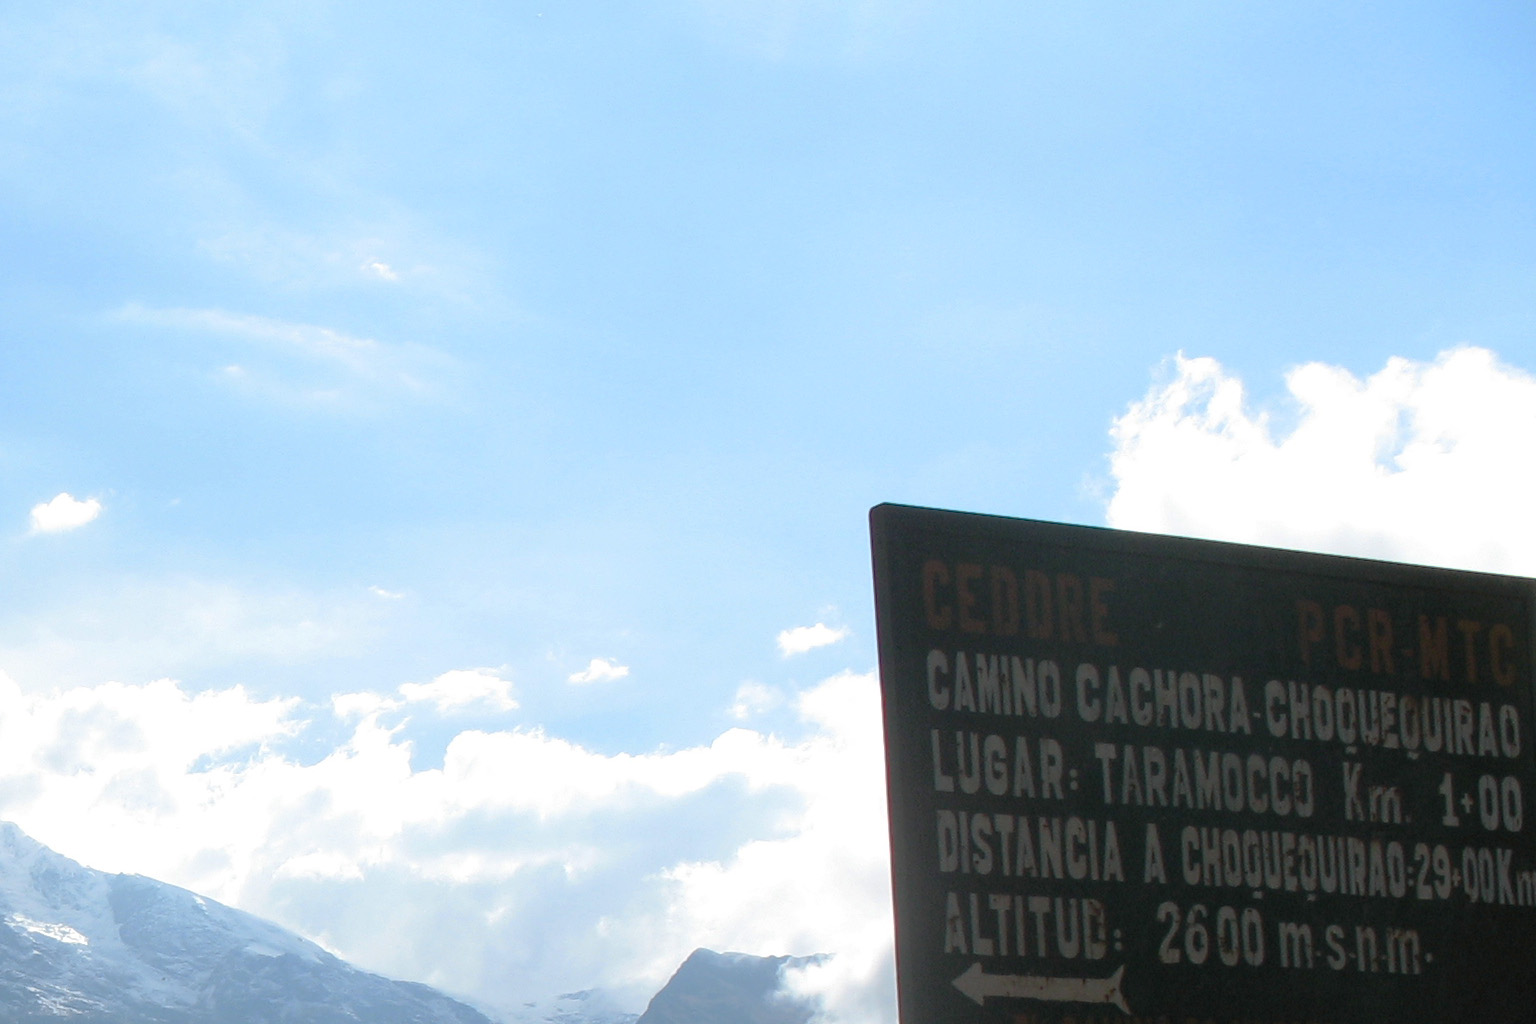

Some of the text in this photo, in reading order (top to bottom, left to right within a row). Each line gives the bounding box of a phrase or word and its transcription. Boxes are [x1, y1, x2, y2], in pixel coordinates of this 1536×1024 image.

[926, 649, 1062, 719] CAMINO
[931, 729, 1080, 799] LUGAR:
[1095, 743, 1314, 818] TARAMOCCO
[1439, 772, 1523, 832] 1+00
[937, 810, 1123, 882] DISTANCIA
[1144, 823, 1166, 884] A
[944, 892, 1124, 960] ALTITUD:
[1157, 901, 1264, 967] 2600
